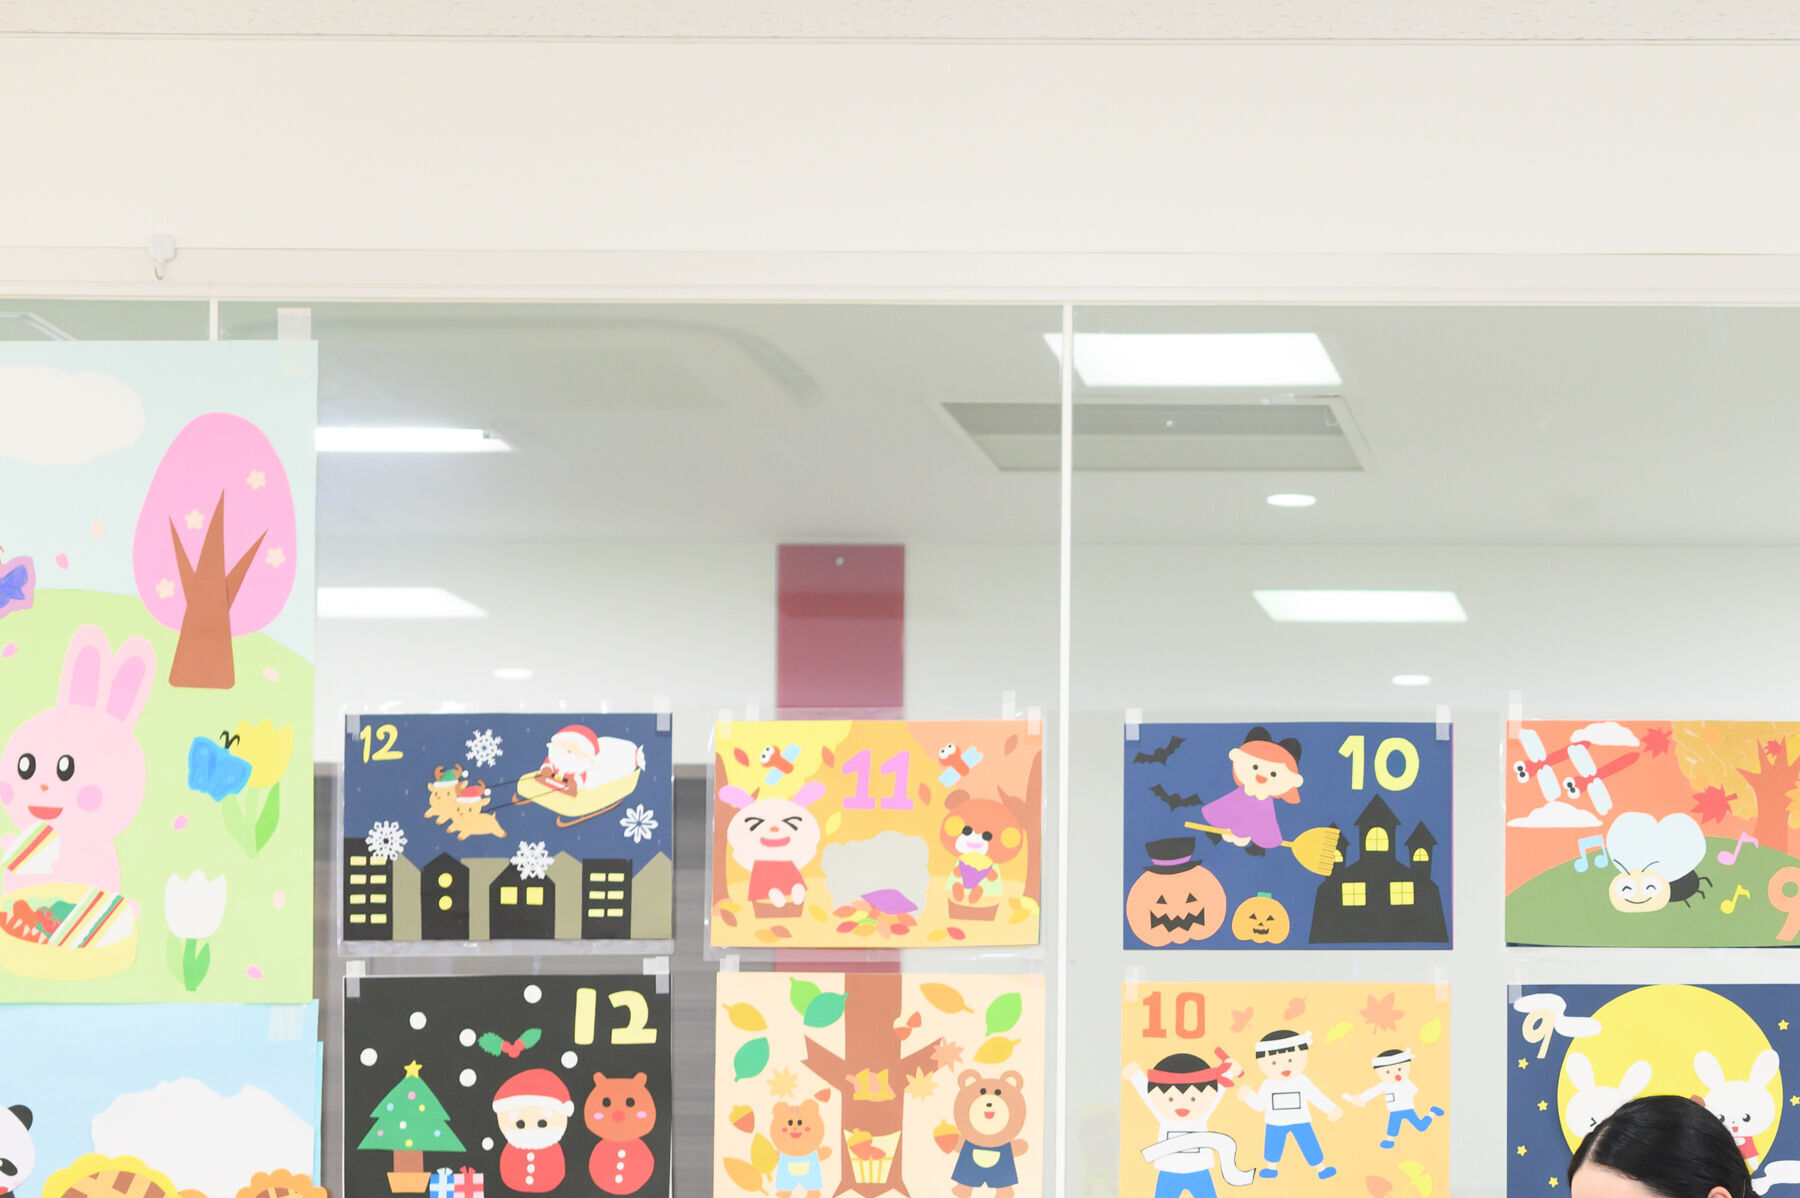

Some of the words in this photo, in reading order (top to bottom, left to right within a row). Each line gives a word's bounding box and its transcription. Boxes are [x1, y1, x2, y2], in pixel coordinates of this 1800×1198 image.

[359, 724, 404, 763] 12
[1338, 735, 1420, 792] 10
[841, 749, 915, 811] 11
[574, 988, 658, 1045] 12
[1141, 990, 1207, 1040] 10
[1521, 1007, 1557, 1059] 9
[852, 1068, 895, 1101] 11
